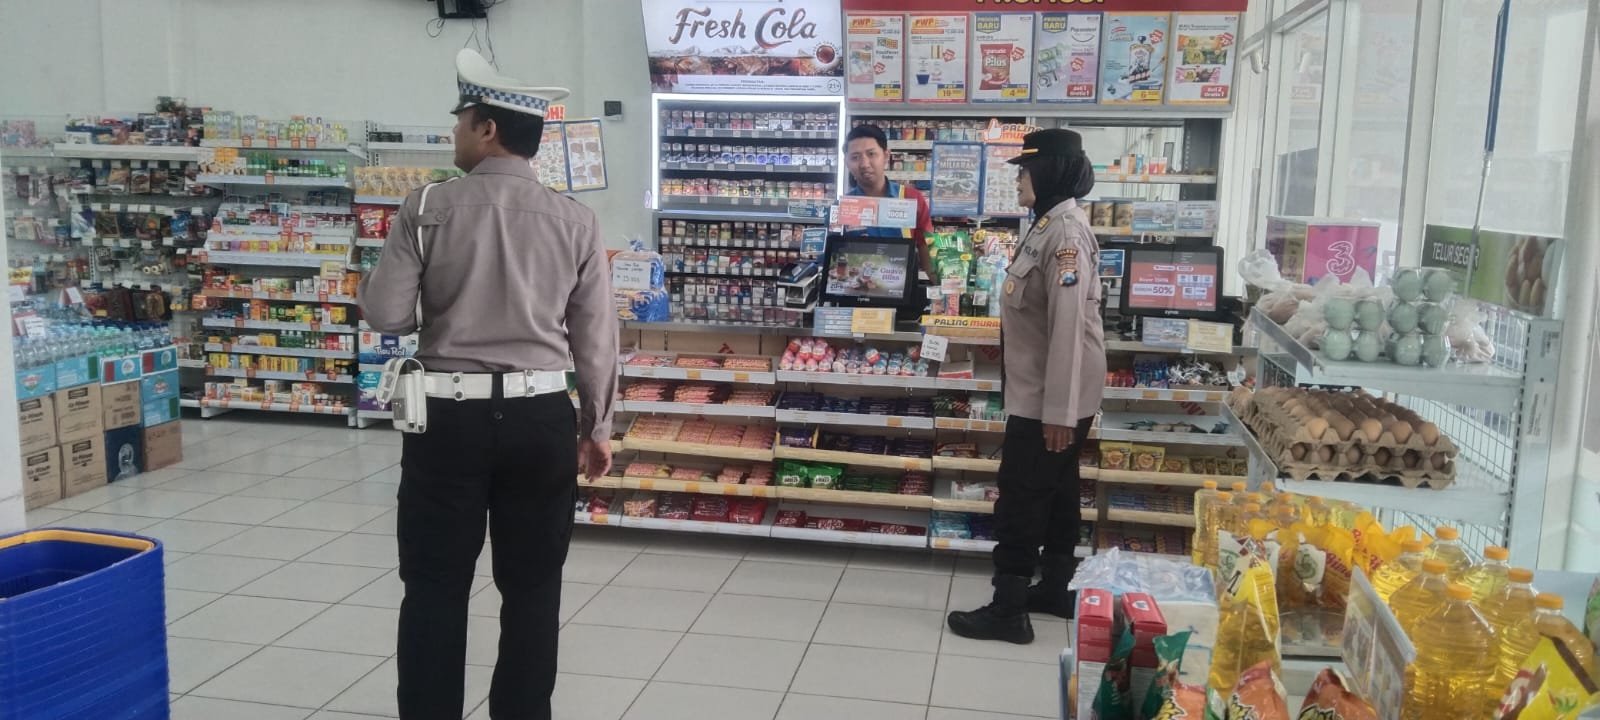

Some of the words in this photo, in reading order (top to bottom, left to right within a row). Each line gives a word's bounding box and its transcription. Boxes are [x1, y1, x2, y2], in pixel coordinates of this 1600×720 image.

[669, 6, 746, 45] Fresh
[754, 7, 818, 50] Cola
[977, 21, 1000, 30] BARU
[1043, 21, 1066, 30] BARU
[1432, 241, 1454, 262] TELUR
[1454, 245, 1480, 267] SEGR
[1152, 284, 1173, 294] 50%
[934, 317, 969, 327] PALING
[970, 319, 1001, 329] MURA
